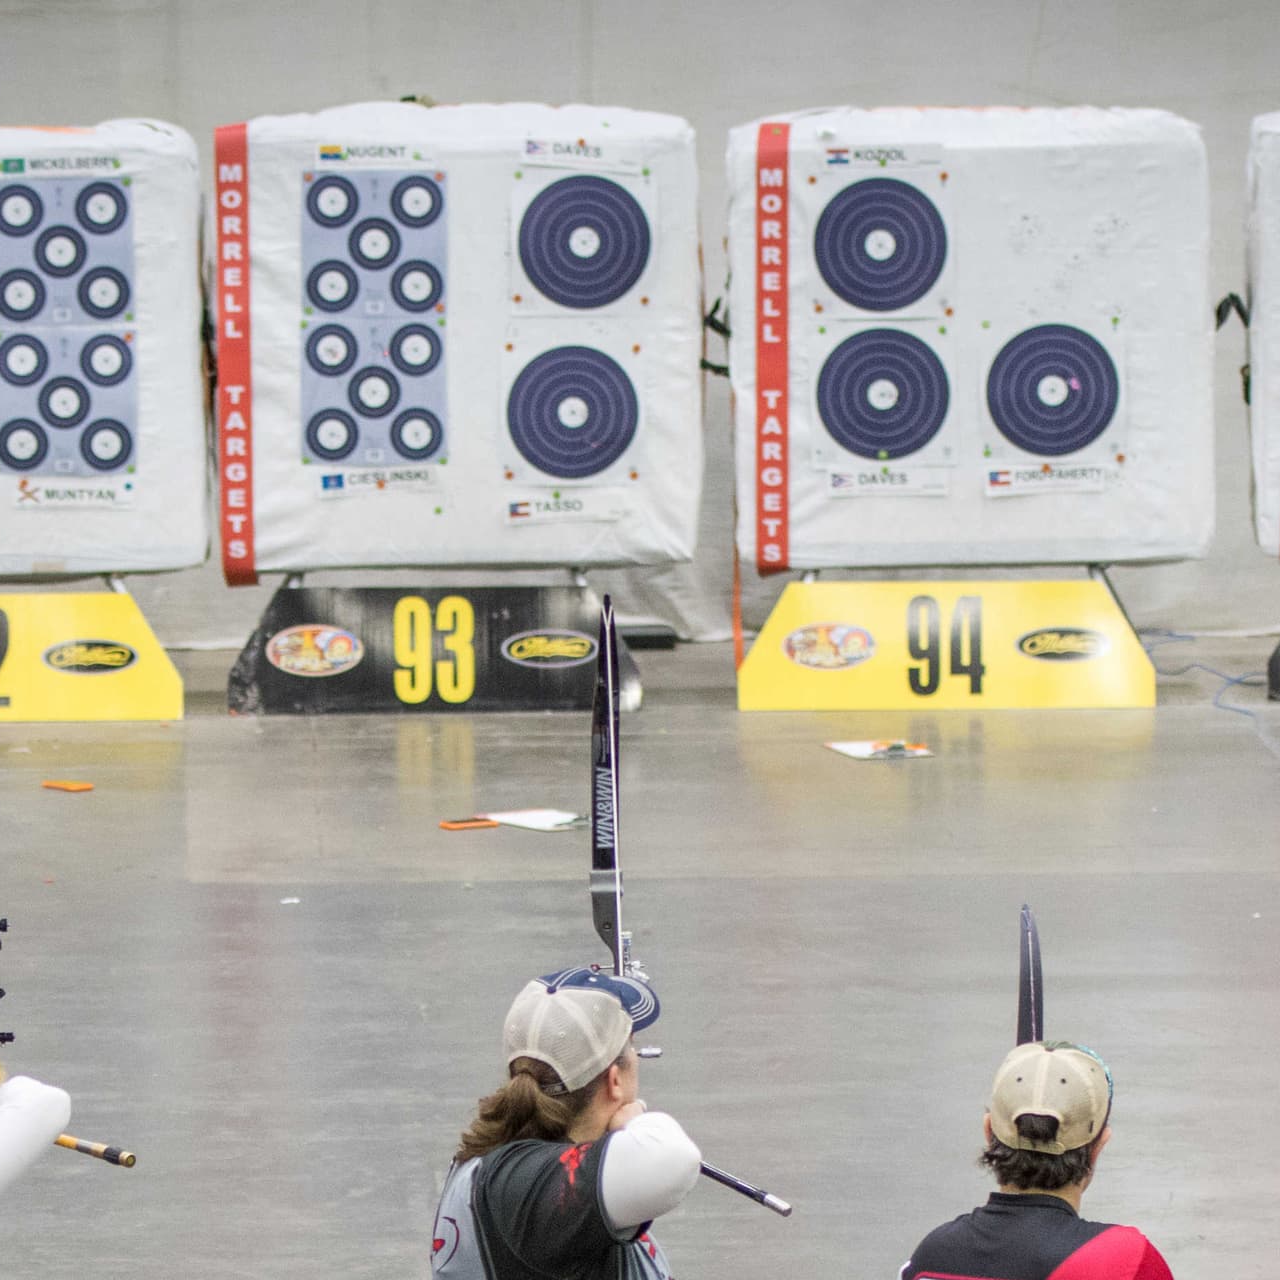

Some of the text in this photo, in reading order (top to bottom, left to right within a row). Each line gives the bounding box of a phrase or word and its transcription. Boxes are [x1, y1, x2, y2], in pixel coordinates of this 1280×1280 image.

[347, 146, 407, 159] NUGENT
[219, 163, 247, 559] MORRELL TARGETS
[760, 168, 783, 563] MORRELL TARGETS
[44, 488, 117, 502] MUNTYAN
[535, 499, 583, 513] TASSO
[858, 473, 907, 486] DAVES
[392, 594, 476, 705] 93
[906, 594, 987, 697] 94
[596, 767, 613, 849] WIN&WIN
